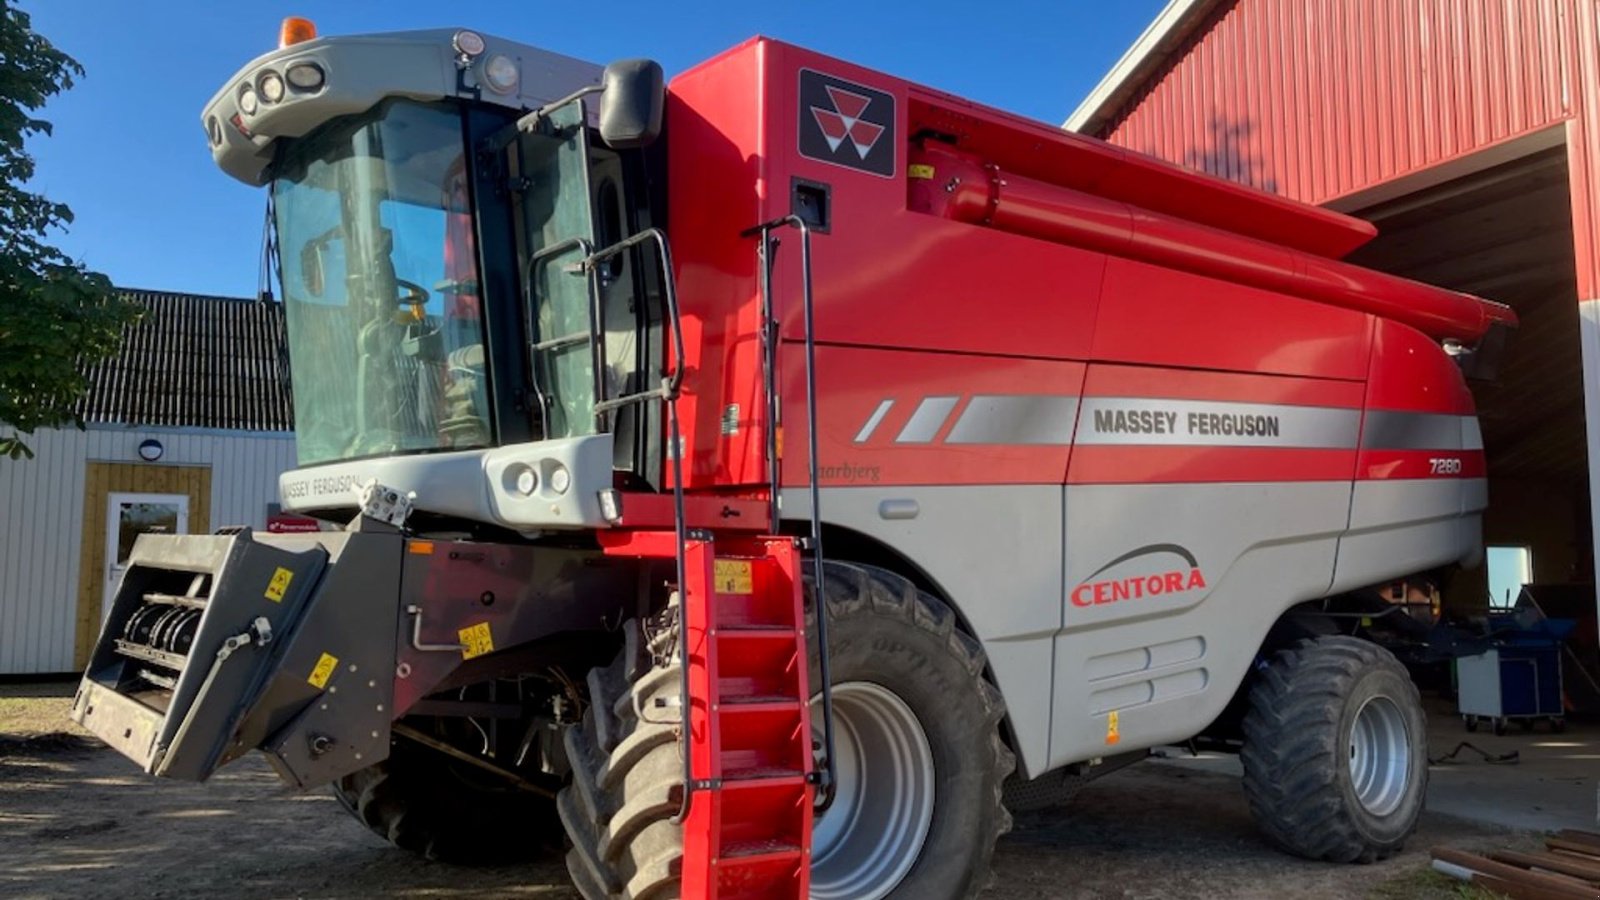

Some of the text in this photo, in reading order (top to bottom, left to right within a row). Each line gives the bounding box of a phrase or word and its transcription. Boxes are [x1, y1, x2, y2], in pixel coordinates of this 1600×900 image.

[1094, 410, 1280, 437] MASSEY FERGUSON
[808, 461, 880, 484] aarbjerg
[1429, 459, 1462, 474] 7280
[1071, 569, 1206, 607] CENTORA
